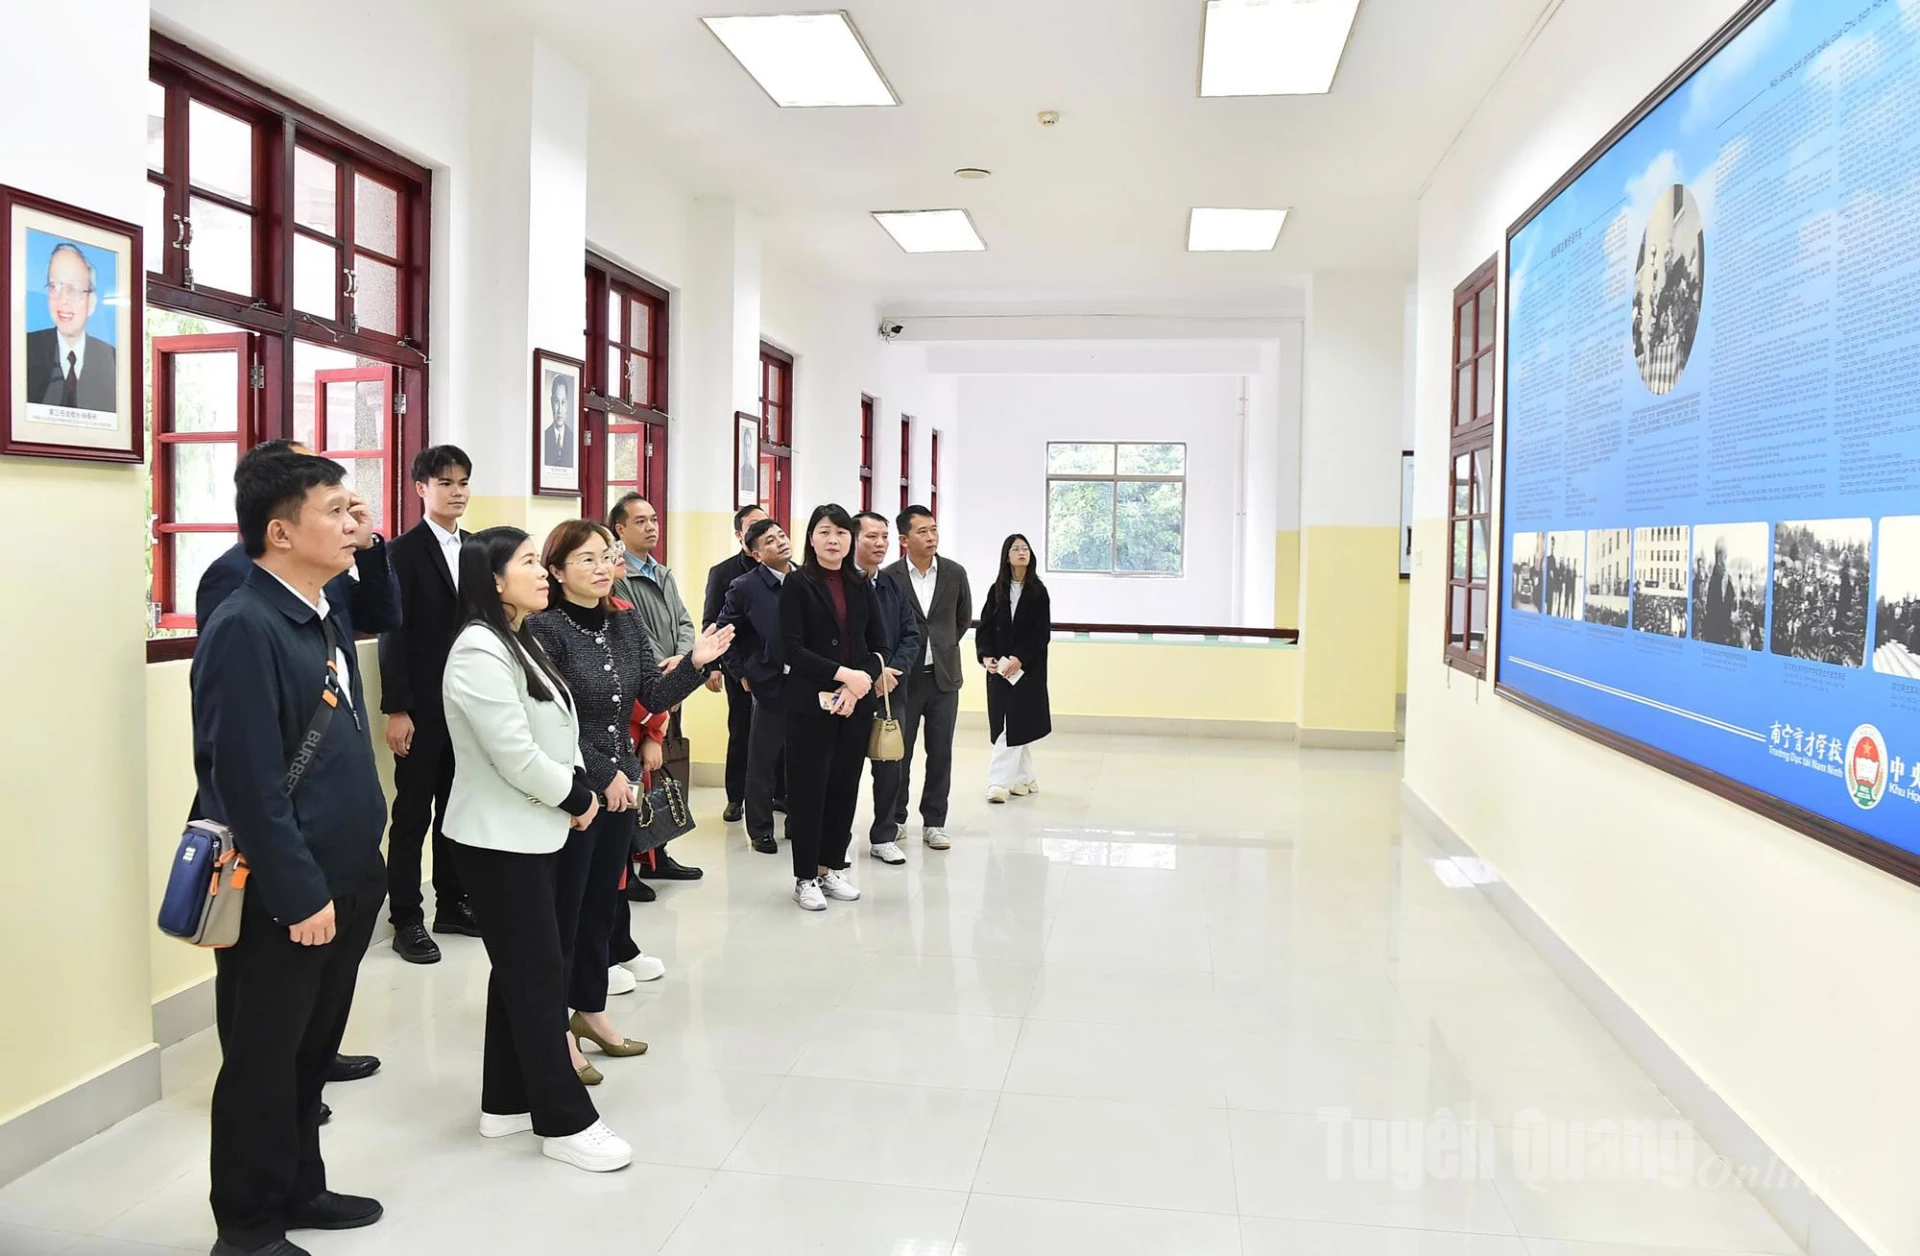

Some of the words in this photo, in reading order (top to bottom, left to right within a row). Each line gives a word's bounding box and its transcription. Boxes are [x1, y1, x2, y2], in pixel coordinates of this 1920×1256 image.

[1812, 759, 1827, 773] Nam
[1827, 764, 1844, 778] Ninh
[1889, 783, 1906, 798] Khu
